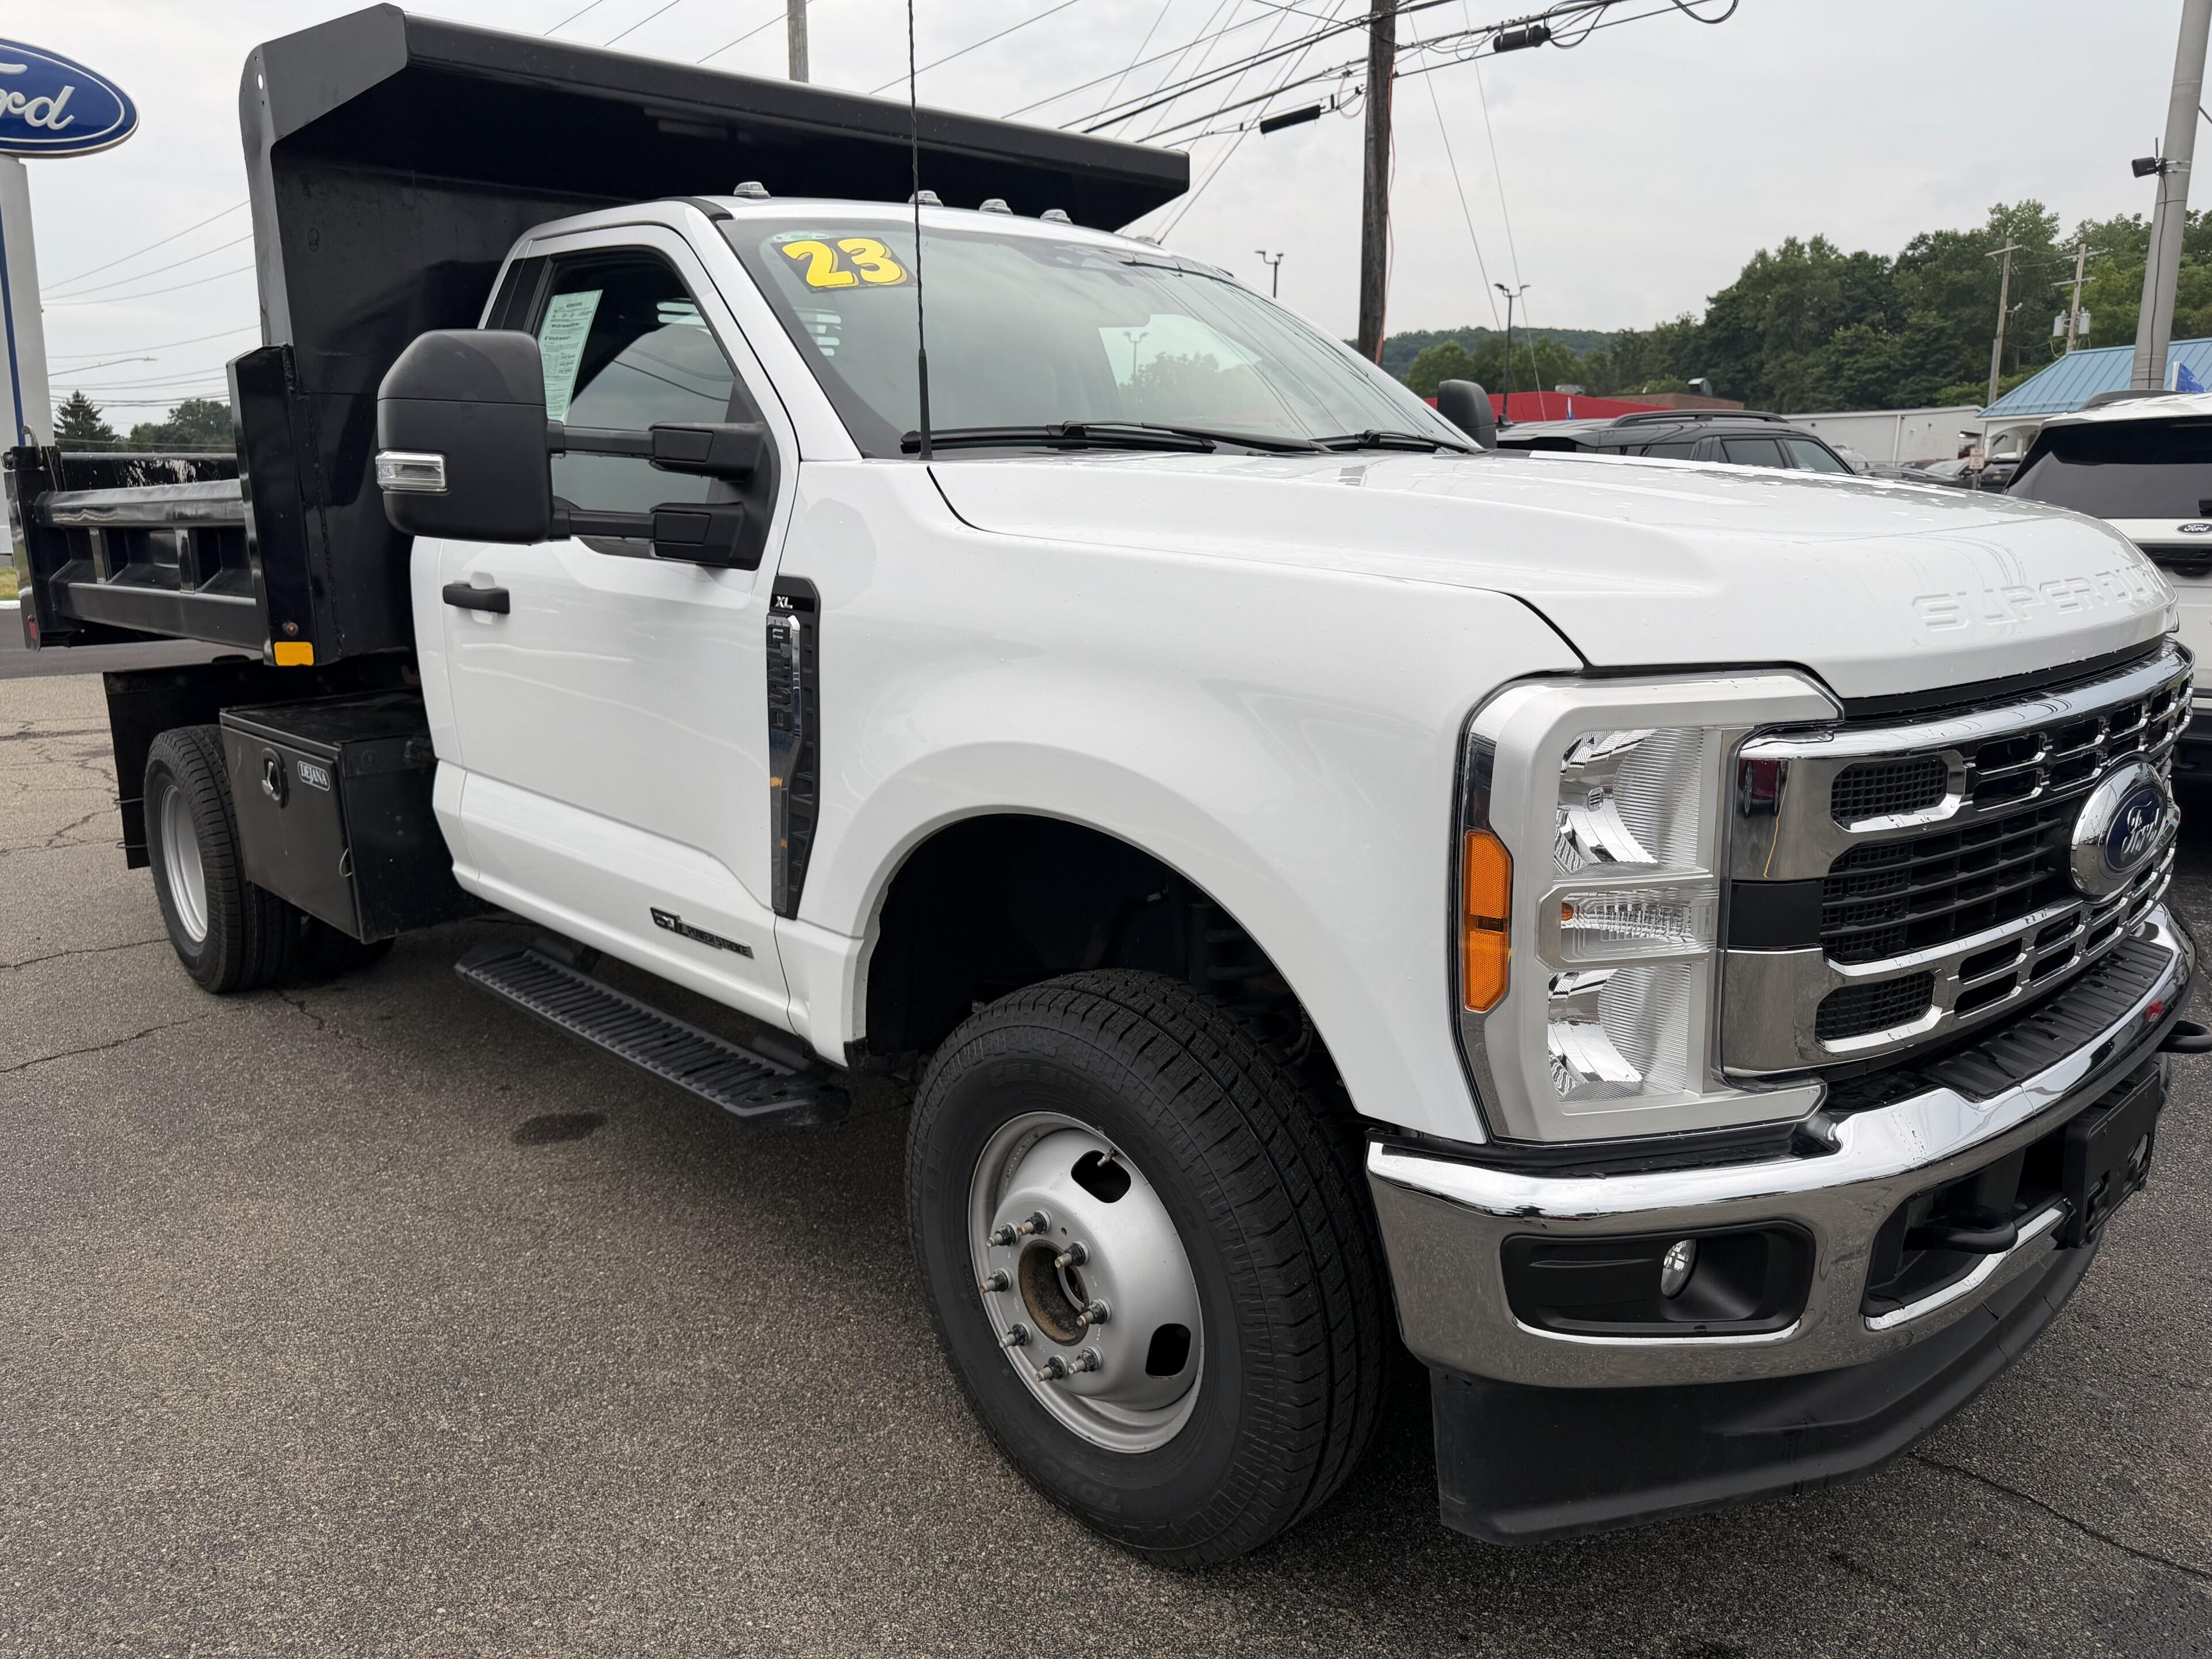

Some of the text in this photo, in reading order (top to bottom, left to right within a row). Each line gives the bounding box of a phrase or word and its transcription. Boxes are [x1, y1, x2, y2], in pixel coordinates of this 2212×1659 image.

[0, 63, 75, 130] rd
[782, 238, 907, 288] 23
[2184, 523, 2210, 532] Ford
[775, 596, 793, 609] XL
[300, 764, 328, 786] DEJANA
[2121, 801, 2160, 855] Ford
